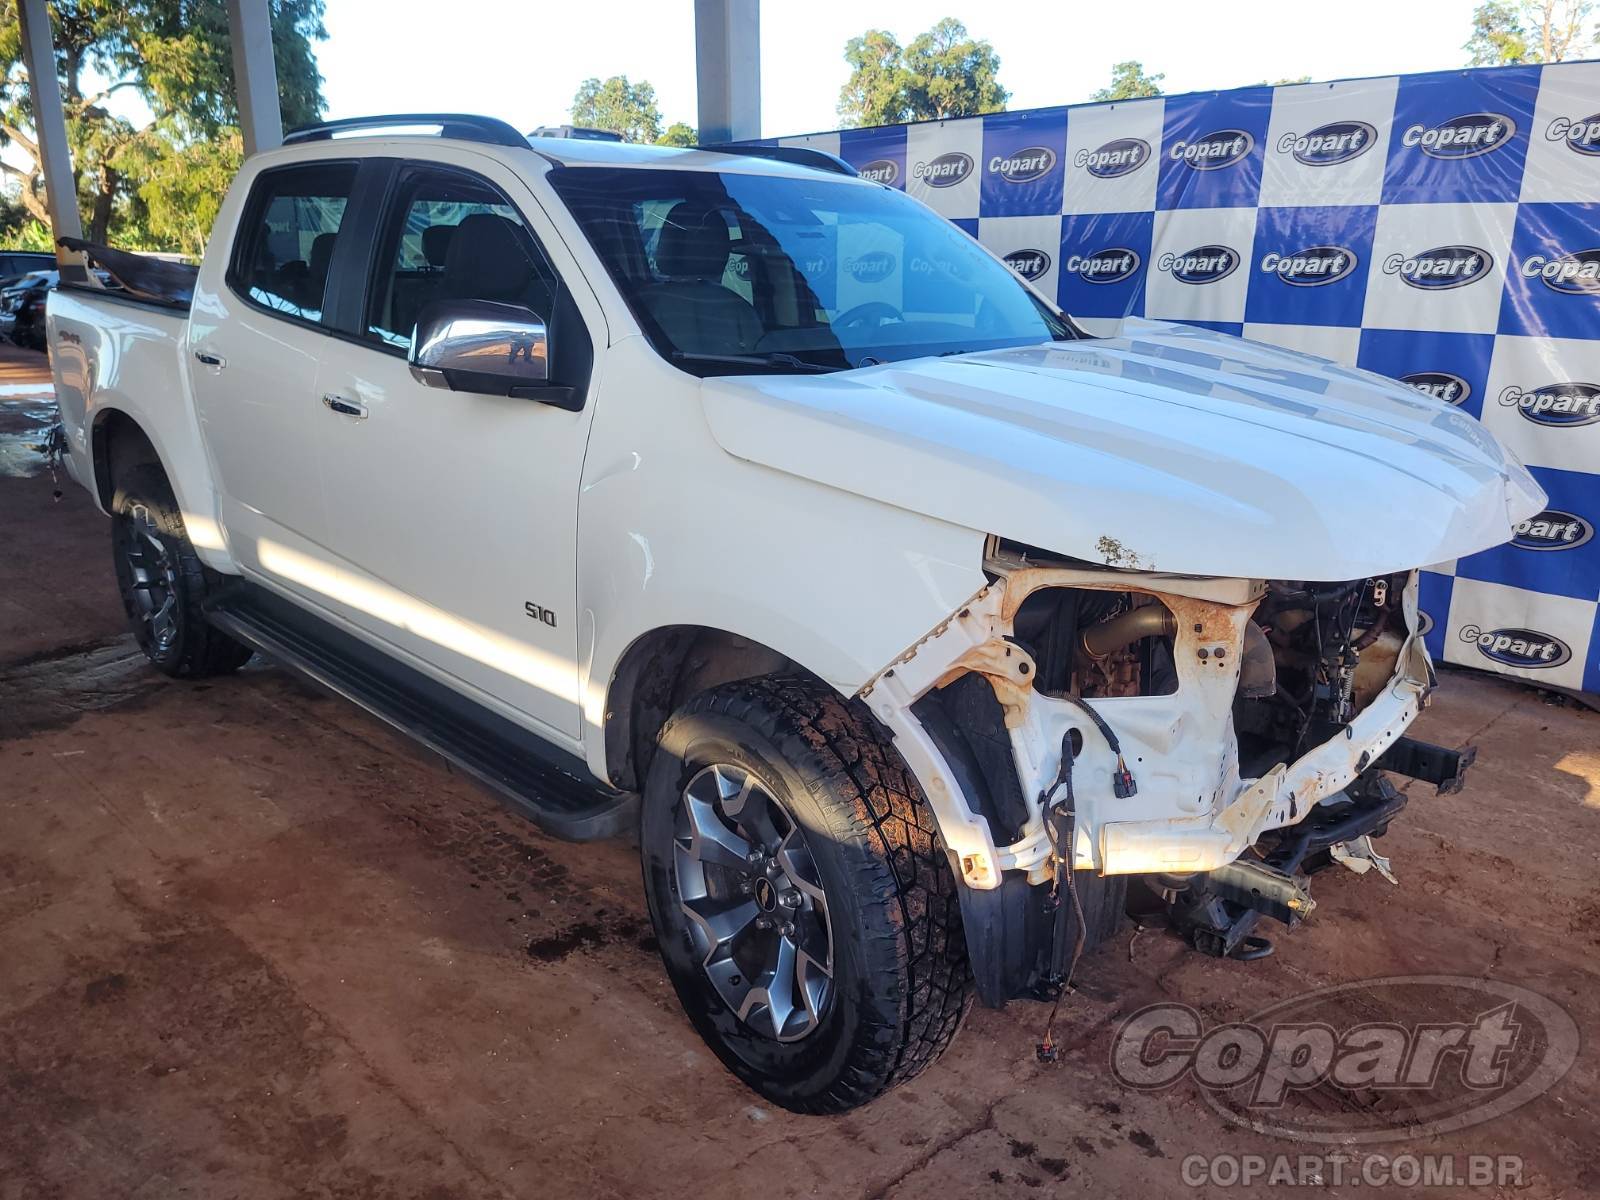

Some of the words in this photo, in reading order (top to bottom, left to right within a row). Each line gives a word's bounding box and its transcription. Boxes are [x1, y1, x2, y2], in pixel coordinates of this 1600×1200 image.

[1278, 130, 1364, 155] Copart
[1402, 121, 1504, 150] Copart
[1545, 117, 1600, 145] Cop
[1074, 144, 1141, 171] Copart
[1170, 135, 1243, 163] Copart
[858, 165, 892, 182] part
[913, 160, 966, 180] Copart
[989, 154, 1048, 177] Copart
[1067, 255, 1131, 280] Copart
[1158, 252, 1228, 280] Copart
[1261, 252, 1346, 276] Copart
[1382, 252, 1479, 278] Copart
[1520, 254, 1600, 284] Copa
[1512, 519, 1578, 542] part
[525, 601, 557, 627] S10
[1459, 624, 1558, 660] Copart
